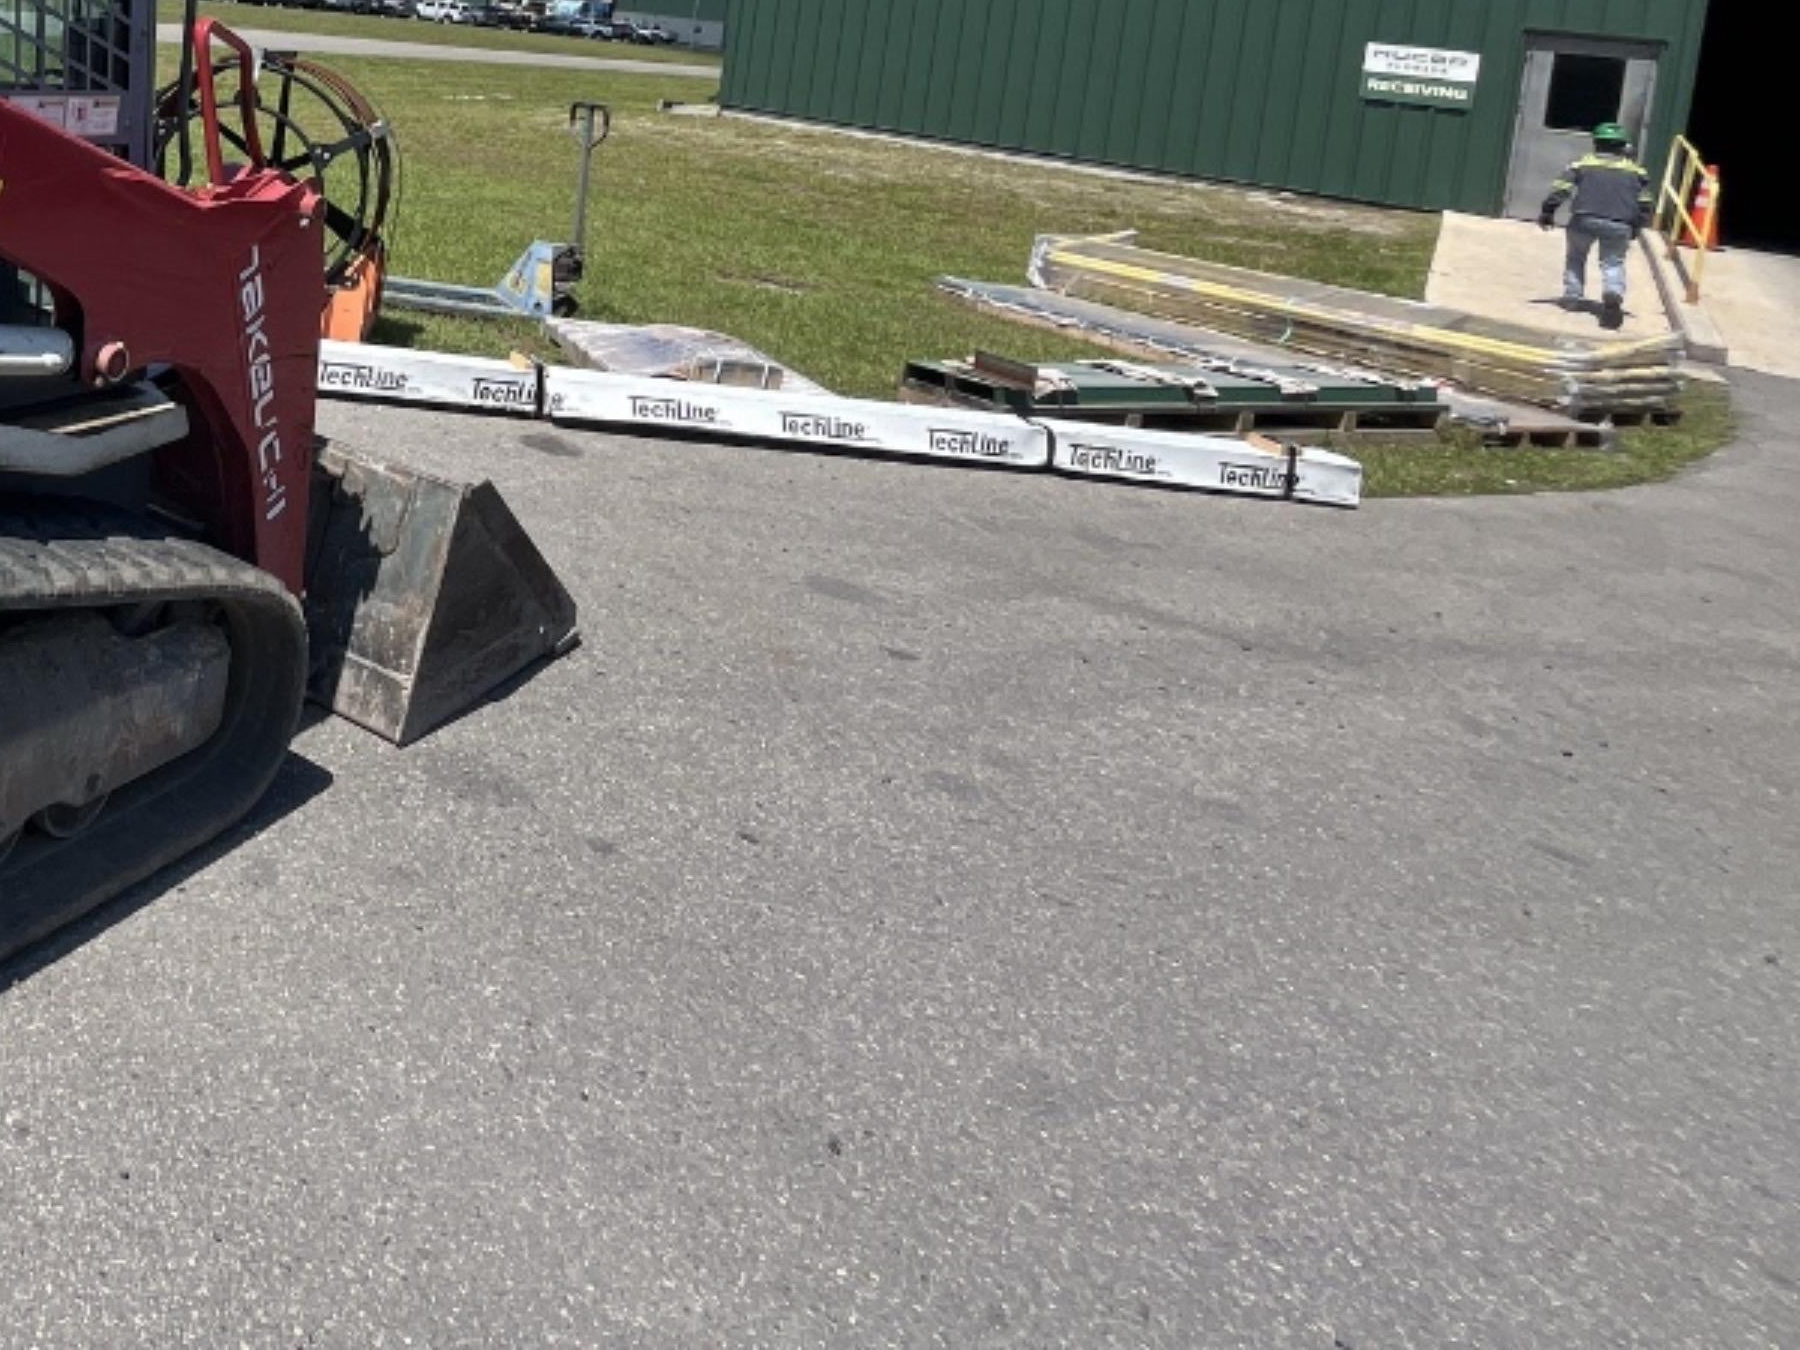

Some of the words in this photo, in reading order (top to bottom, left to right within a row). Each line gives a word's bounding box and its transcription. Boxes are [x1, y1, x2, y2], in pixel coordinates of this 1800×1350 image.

[319, 362, 409, 390] TechLine
[472, 377, 566, 408] TechLie
[627, 395, 718, 423] TechLine
[779, 411, 868, 441] TechLine
[928, 428, 1011, 457] TechLine
[1068, 443, 1158, 475] TechLine
